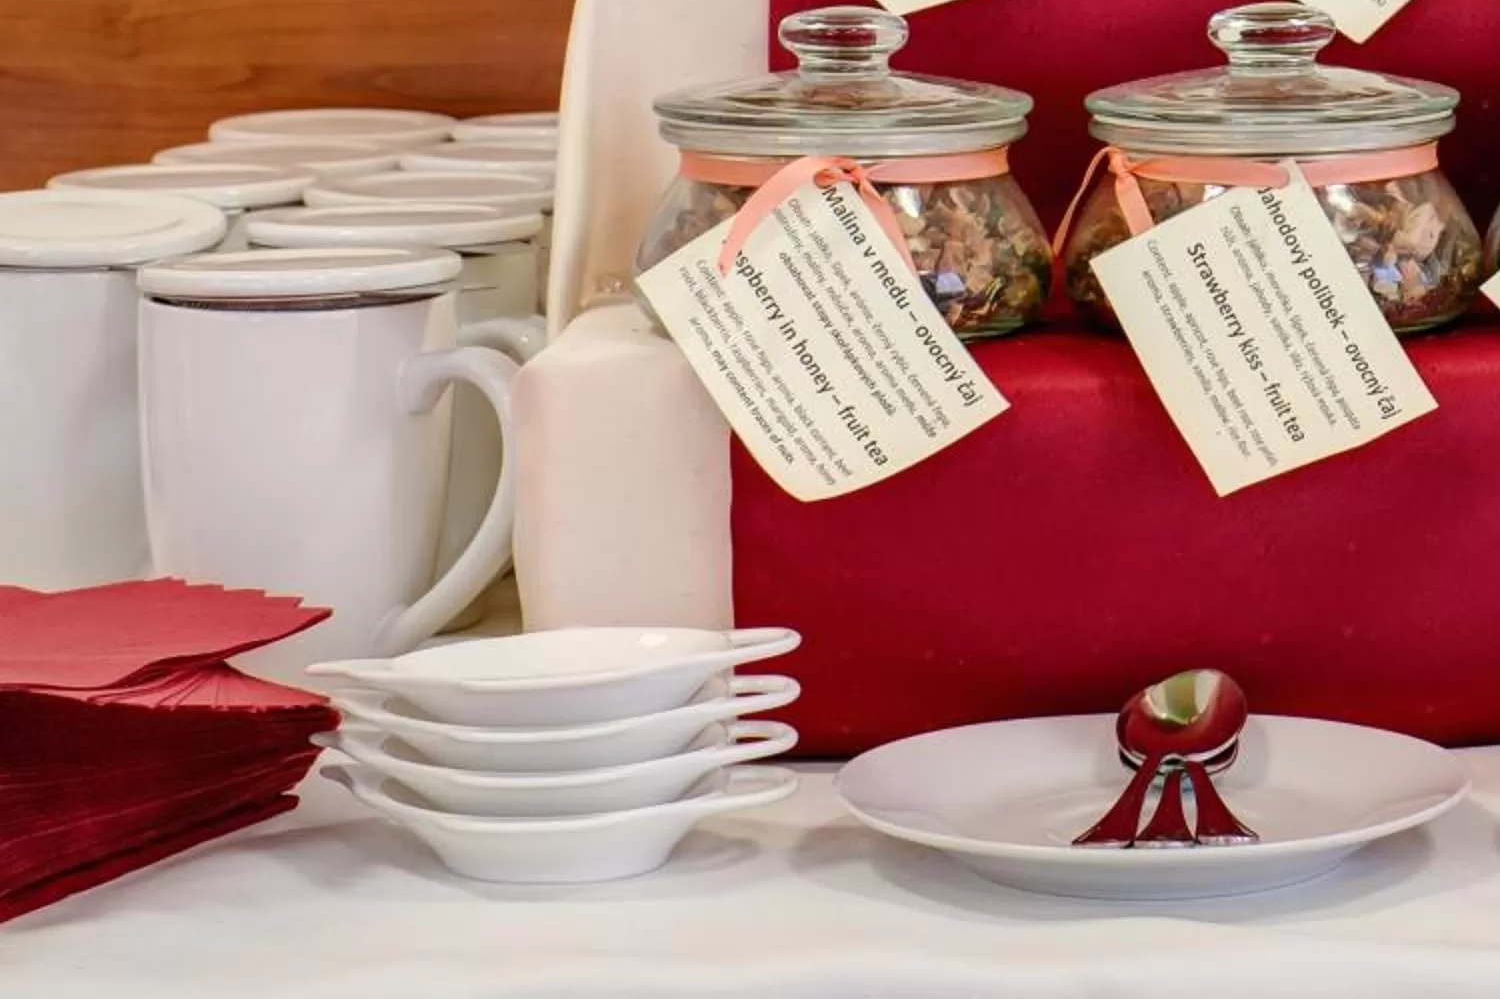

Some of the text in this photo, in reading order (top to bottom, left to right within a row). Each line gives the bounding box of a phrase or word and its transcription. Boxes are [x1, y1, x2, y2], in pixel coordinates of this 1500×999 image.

[722, 240, 784, 321] spberry
[778, 318, 797, 342] in
[791, 338, 834, 394] honey
[836, 404, 870, 442] fruit
[862, 439, 889, 466] tea
[820, 185, 866, 245] Malina
[862, 244, 877, 258] v
[870, 259, 910, 310] medu
[914, 325, 964, 382] ovocný
[956, 379, 984, 407] čaj
[1186, 242, 1245, 338] Strawberry
[1237, 336, 1263, 371] kiss
[1262, 381, 1292, 418] fruit
[1282, 415, 1305, 442] tea
[1256, 185, 1312, 265] Jahodový
[1297, 266, 1345, 329] polibek
[1344, 342, 1388, 396] ovocný
[1376, 394, 1402, 420] čaj
